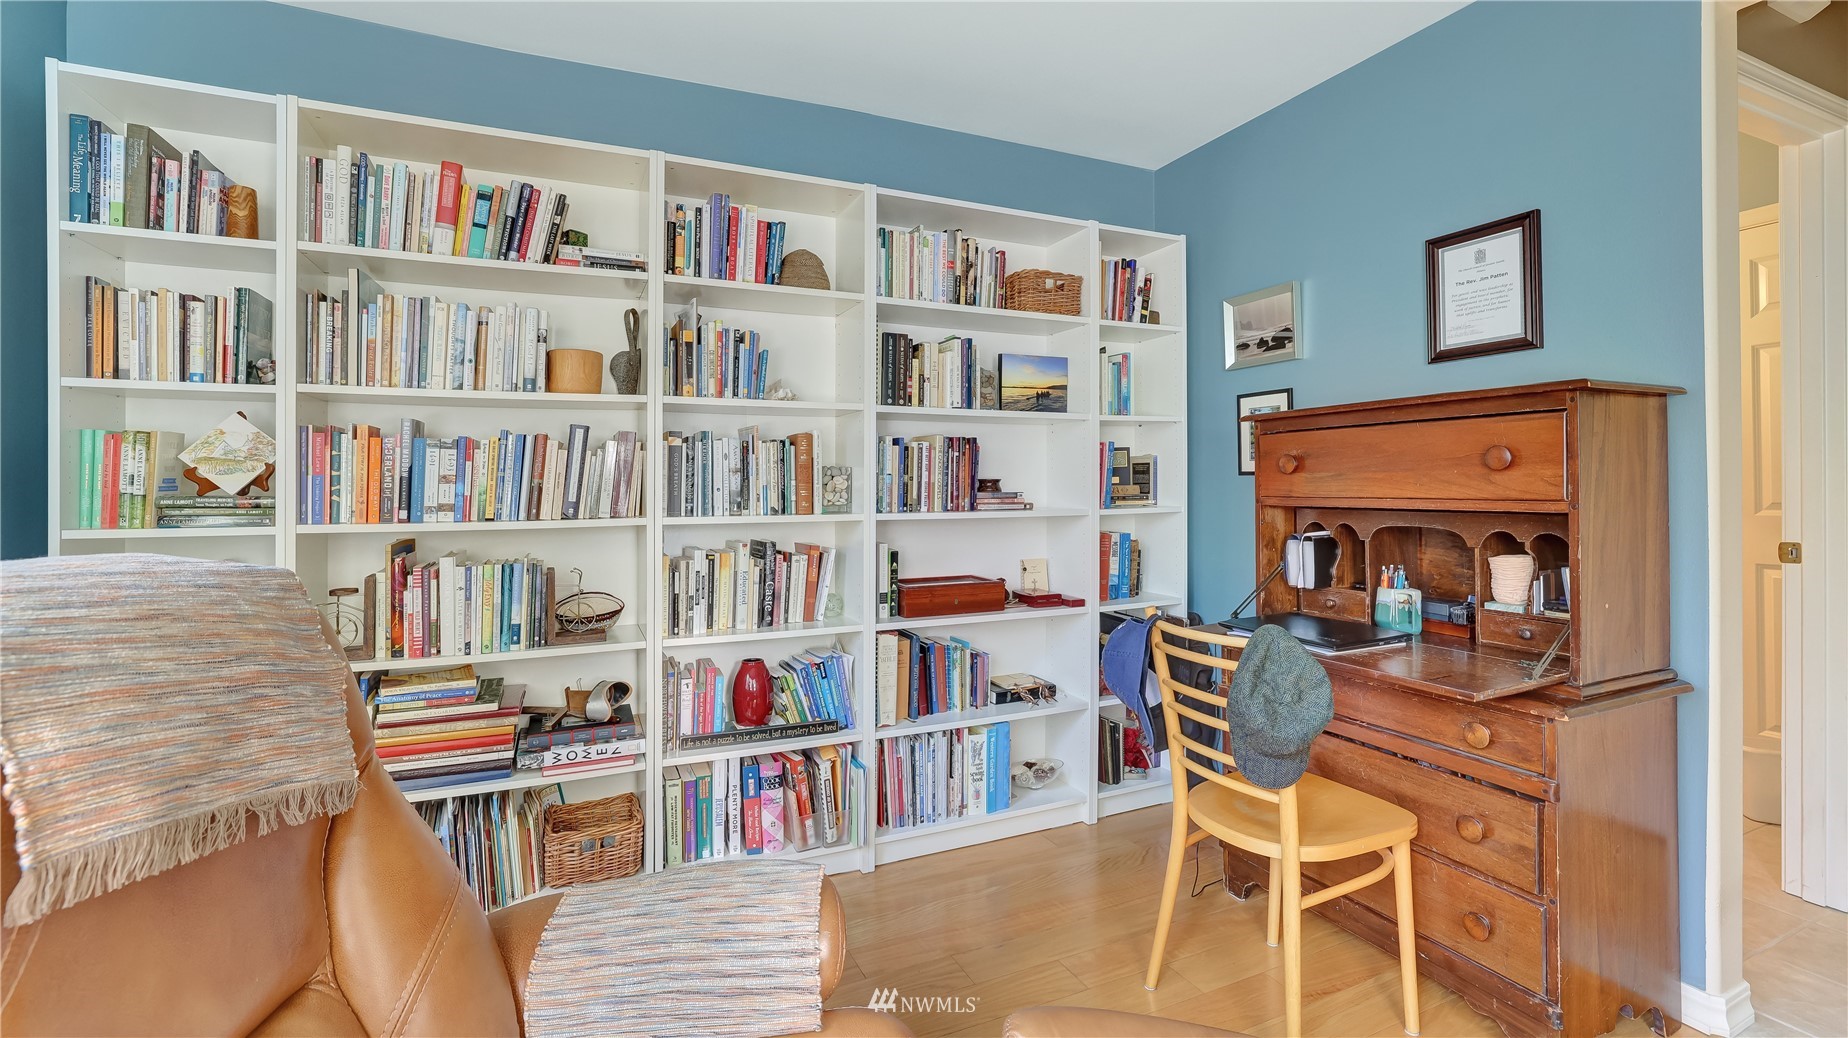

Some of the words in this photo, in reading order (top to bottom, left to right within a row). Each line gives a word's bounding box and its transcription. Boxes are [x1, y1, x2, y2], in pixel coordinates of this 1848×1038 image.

[77, 141, 87, 154] Life
[70, 156, 83, 194] Meaning
[339, 158, 349, 185] GOD
[501, 217, 512, 253] CONVICTIONS
[942, 262, 946, 270] WE
[1489, 271, 1509, 279] Patten
[941, 289, 946, 298] DO
[402, 422, 411, 447] RACHEL
[122, 444, 130, 462] ANNE
[136, 449, 145, 465] ANNE
[385, 438, 393, 488] UNDERLAND
[401, 449, 409, 478] MADDOW
[428, 450, 436, 466] 1491
[446, 453, 455, 472] 1493
[121, 463, 129, 492] LAMOTT
[135, 465, 144, 492] LAMOTT
[765, 581, 775, 612] Caste
[392, 694, 418, 702] Anatomy
[683, 740, 695, 749] Life
[702, 739, 712, 747] not
[717, 736, 735, 746] puzzle
[736, 734, 743, 742] to
[751, 733, 772, 741] solved,
[772, 731, 781, 739] but
[787, 728, 809, 738] mystery
[816, 725, 823, 733] be
[824, 724, 837, 732] lived
[403, 751, 448, 761] WHITWORTH
[552, 747, 622, 764] WOMEN
[715, 798, 723, 827] JERUSALEM
